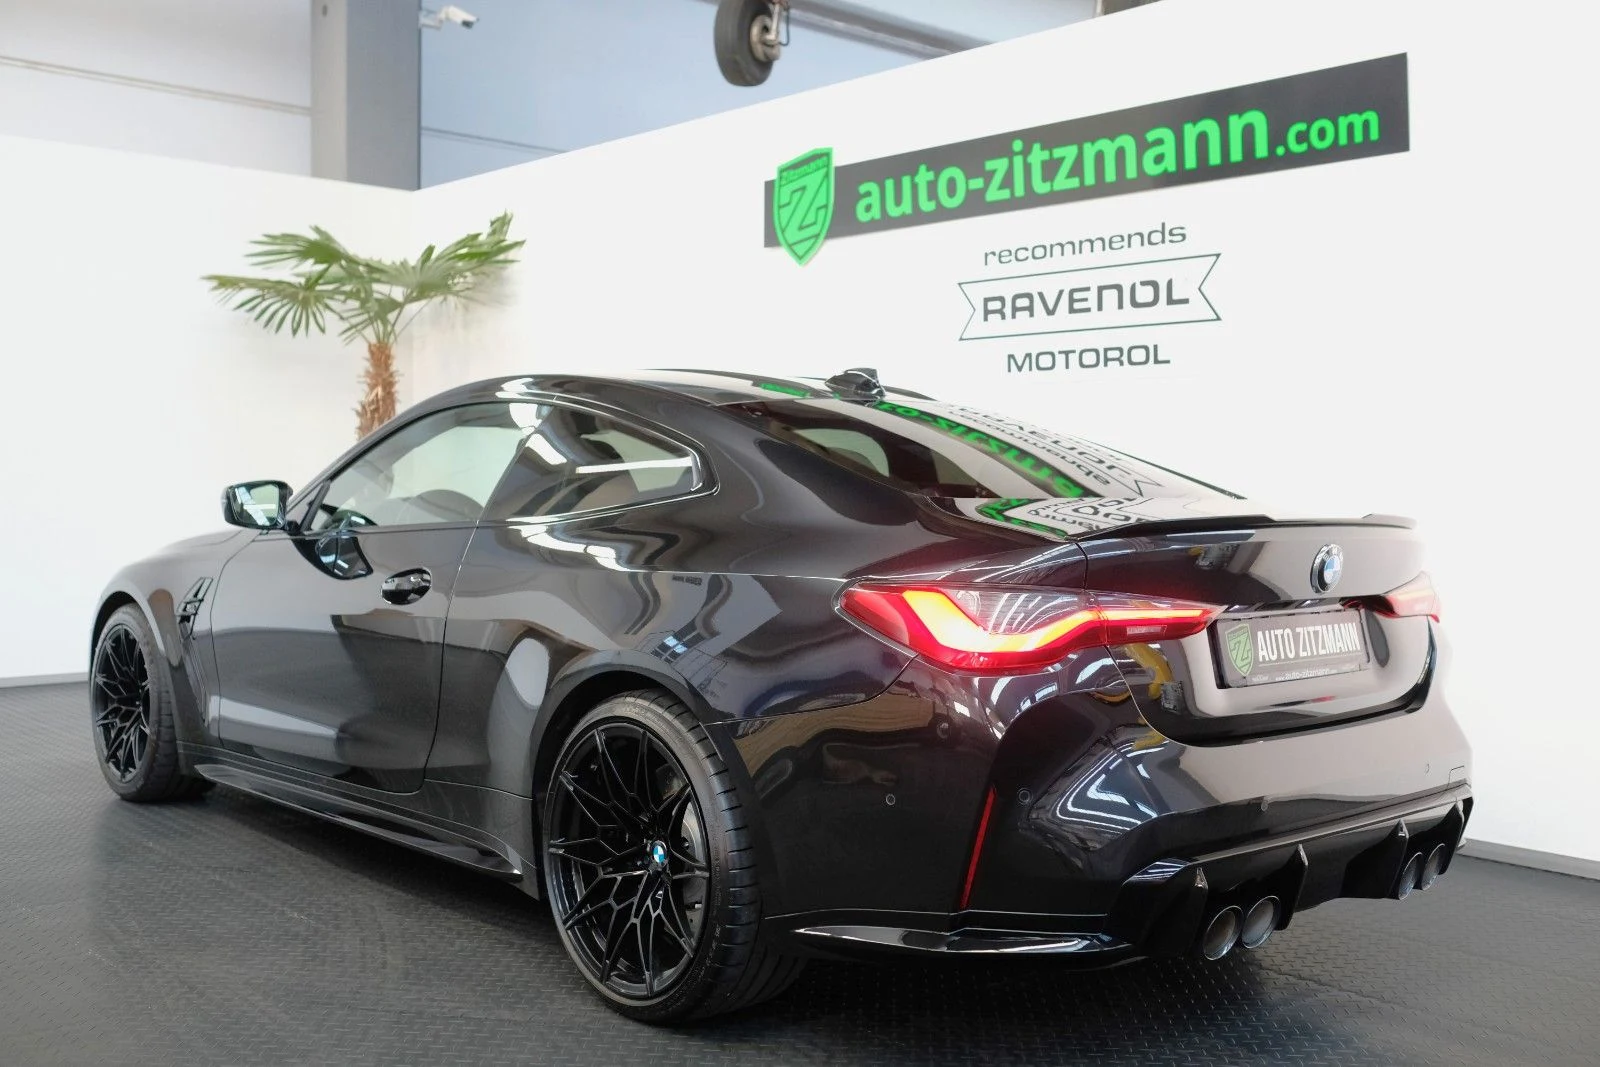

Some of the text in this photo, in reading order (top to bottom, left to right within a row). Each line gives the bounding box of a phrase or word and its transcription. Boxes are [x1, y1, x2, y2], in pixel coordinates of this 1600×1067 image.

[856, 108, 1381, 223] auto-zitzmann.com
[983, 221, 1187, 266] recommends
[982, 277, 1190, 323] RAVENOL
[1006, 343, 1171, 373] MOTOROL
[1257, 622, 1361, 662] AUTO ZITZMANN
